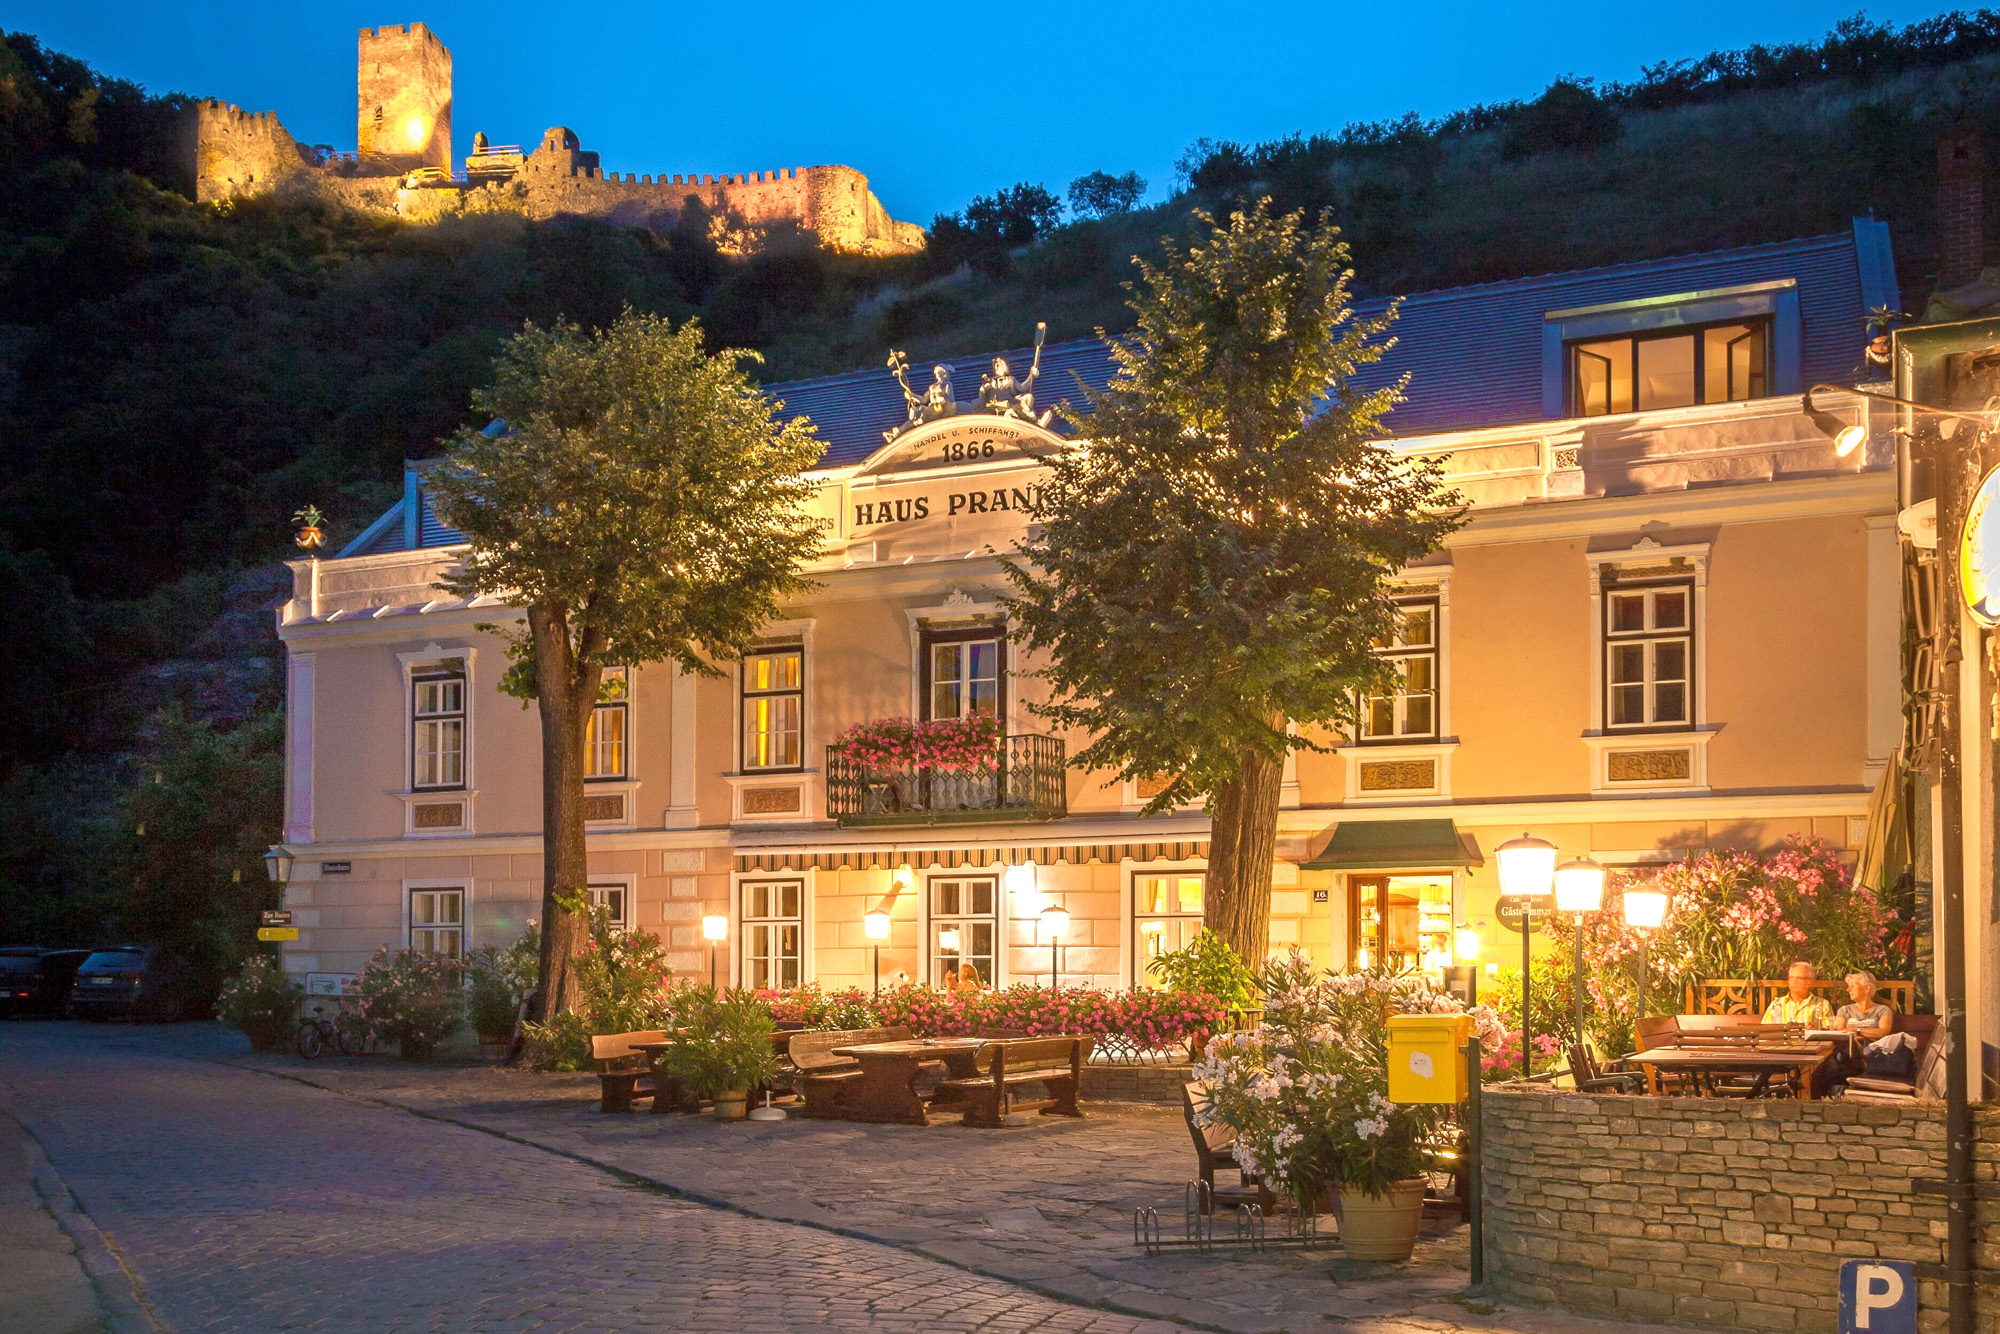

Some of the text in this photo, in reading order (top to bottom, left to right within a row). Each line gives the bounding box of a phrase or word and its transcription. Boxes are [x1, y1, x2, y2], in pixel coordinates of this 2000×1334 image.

[913, 432, 947, 450] HANDEL
[968, 427, 1020, 439] SCHIFFAHRT
[941, 439, 995, 463] 1866
[855, 496, 929, 526] HAUS
[1856, 1264, 1904, 1329] P
